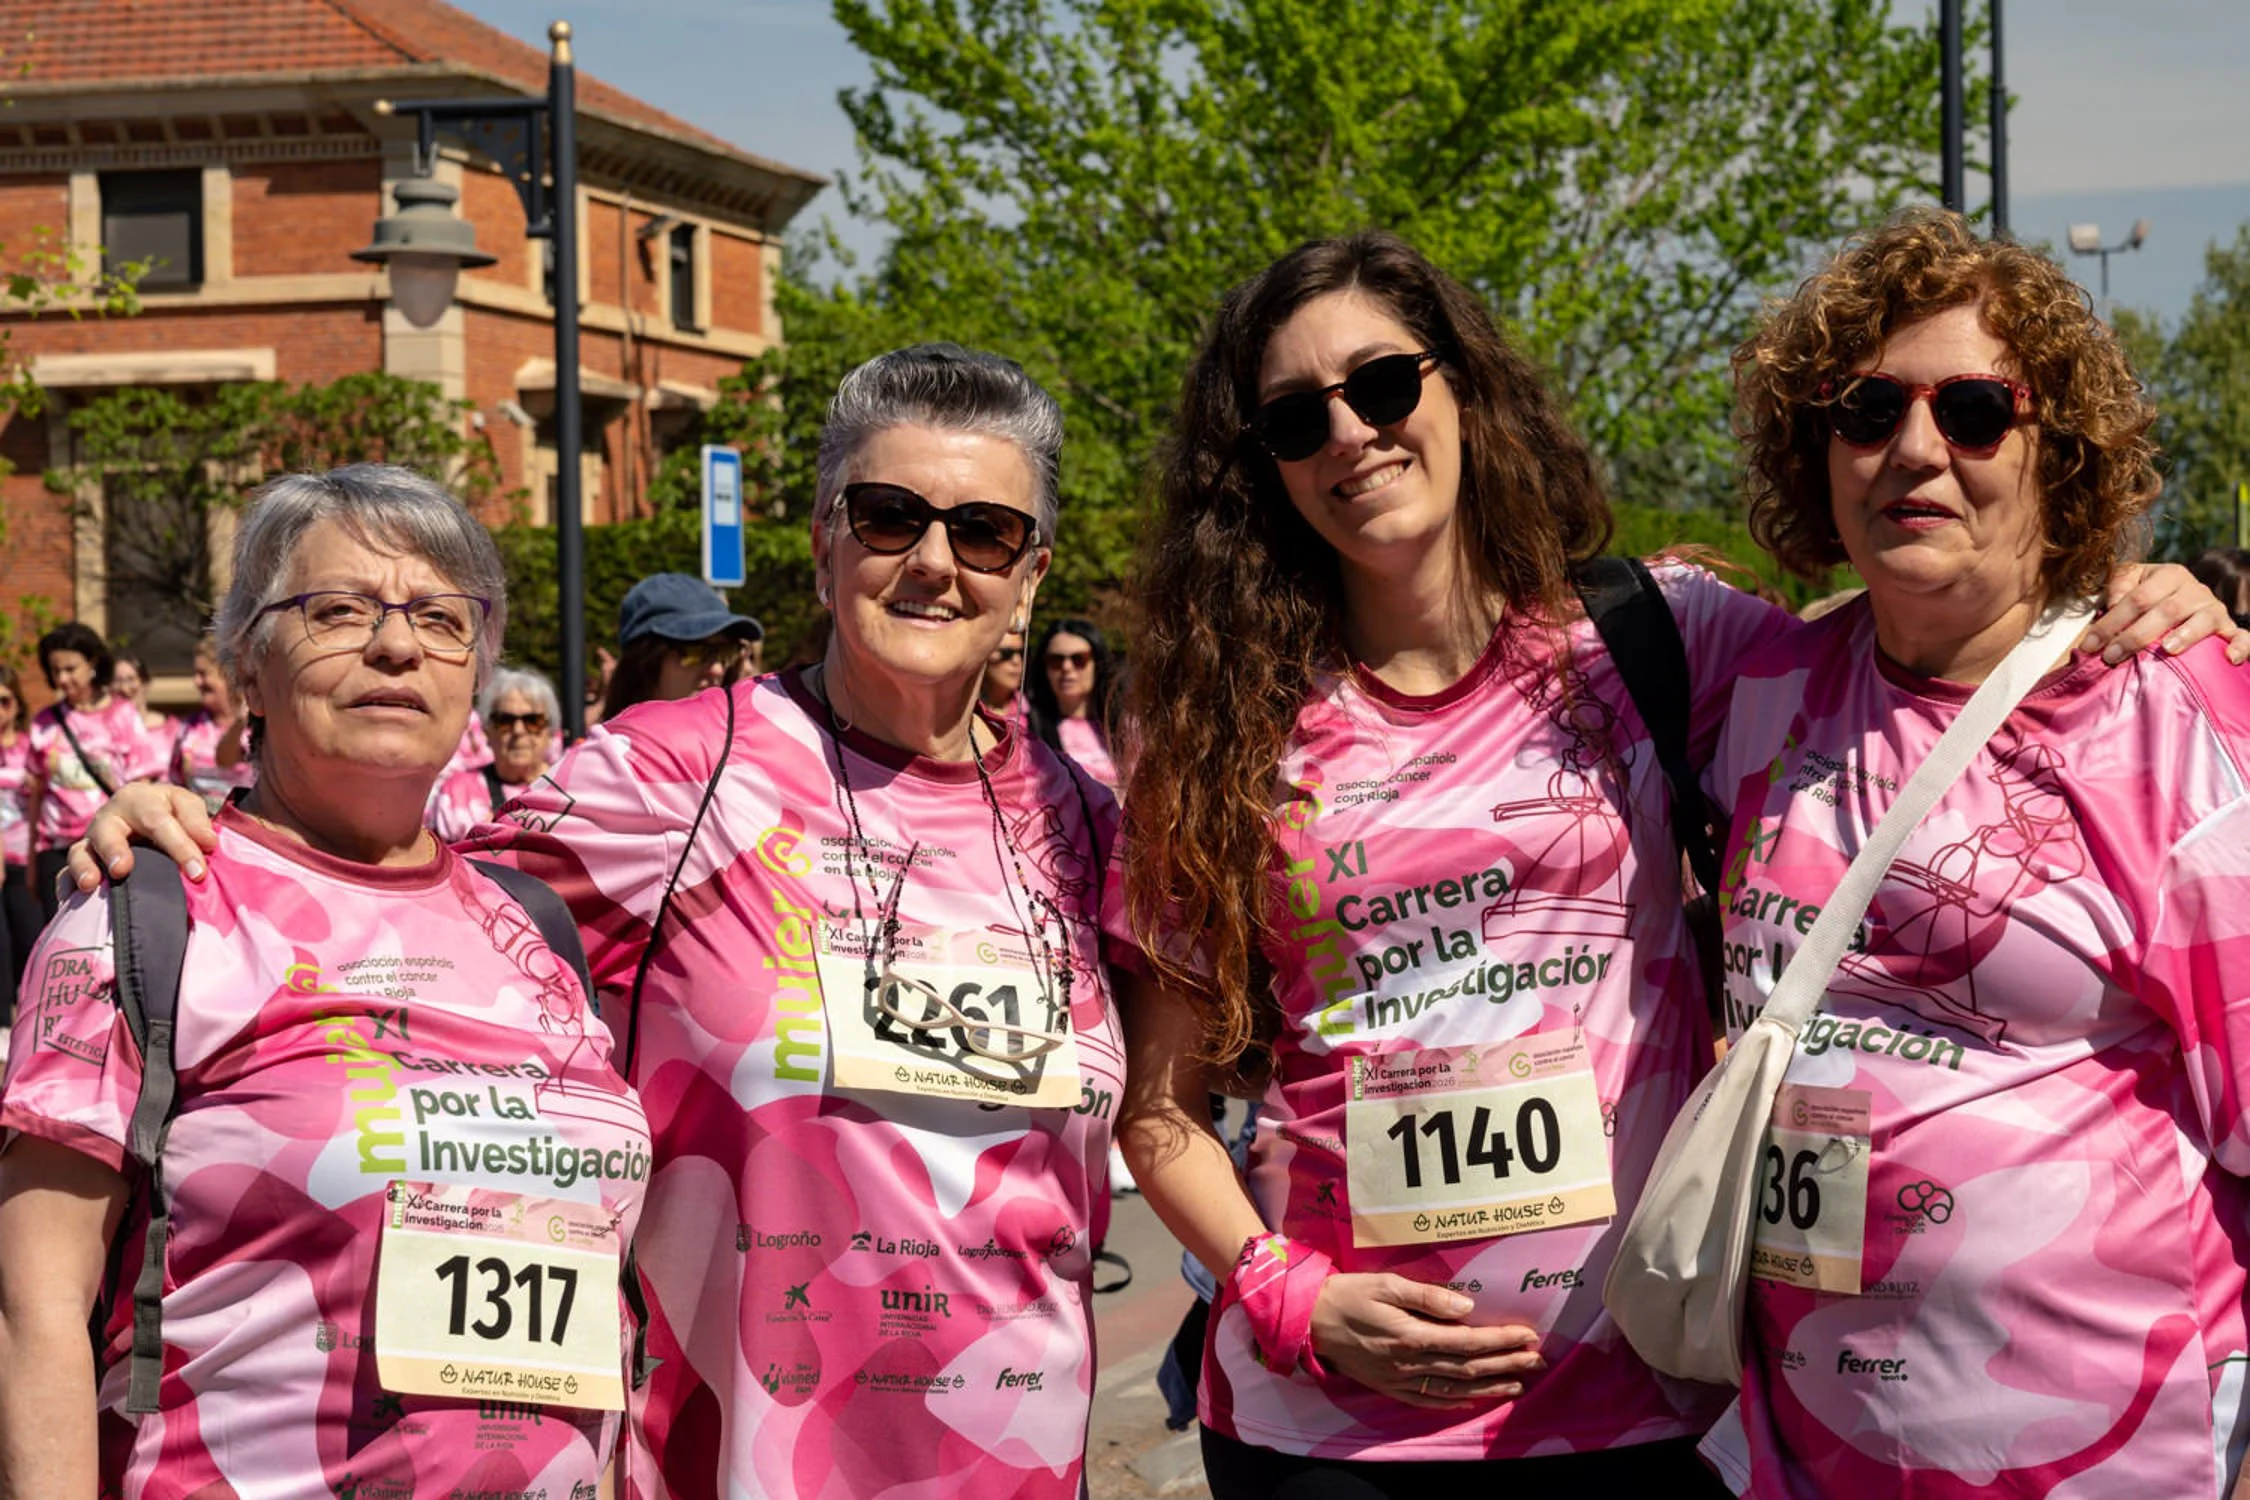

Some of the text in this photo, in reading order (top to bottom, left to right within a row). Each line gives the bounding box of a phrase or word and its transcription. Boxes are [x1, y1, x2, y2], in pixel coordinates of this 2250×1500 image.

[823, 864, 841, 876] en
[871, 852, 884, 864] el
[1325, 839, 1369, 884] XI
[1335, 866, 1513, 933] Carrera
[1356, 925, 1478, 992] por la
[763, 890, 823, 1084] mujer
[1364, 943, 1614, 1031] Investigación
[365, 1007, 411, 1042] XI
[864, 977, 1025, 1056] 2261
[391, 1050, 551, 1081] Carrera
[913, 1070, 1009, 1092] NATUR HOUSE
[1365, 1066, 1379, 1081] XI
[1381, 1067, 1417, 1080] Carrera
[1418, 1064, 1438, 1078] por
[410, 1085, 536, 1126] por la
[1386, 1096, 1561, 1189] 1140
[1757, 1143, 1821, 1231] 36
[424, 1199, 469, 1215] Carrera
[470, 1205, 490, 1219] por
[491, 1206, 503, 1219] la
[1434, 1202, 1545, 1230] NATUR HOUSE
[756, 1230, 822, 1250] Logroño
[876, 1237, 941, 1258] La Rioja
[434, 1254, 579, 1348] 1317
[461, 1367, 562, 1392] NATUR HOUSE
